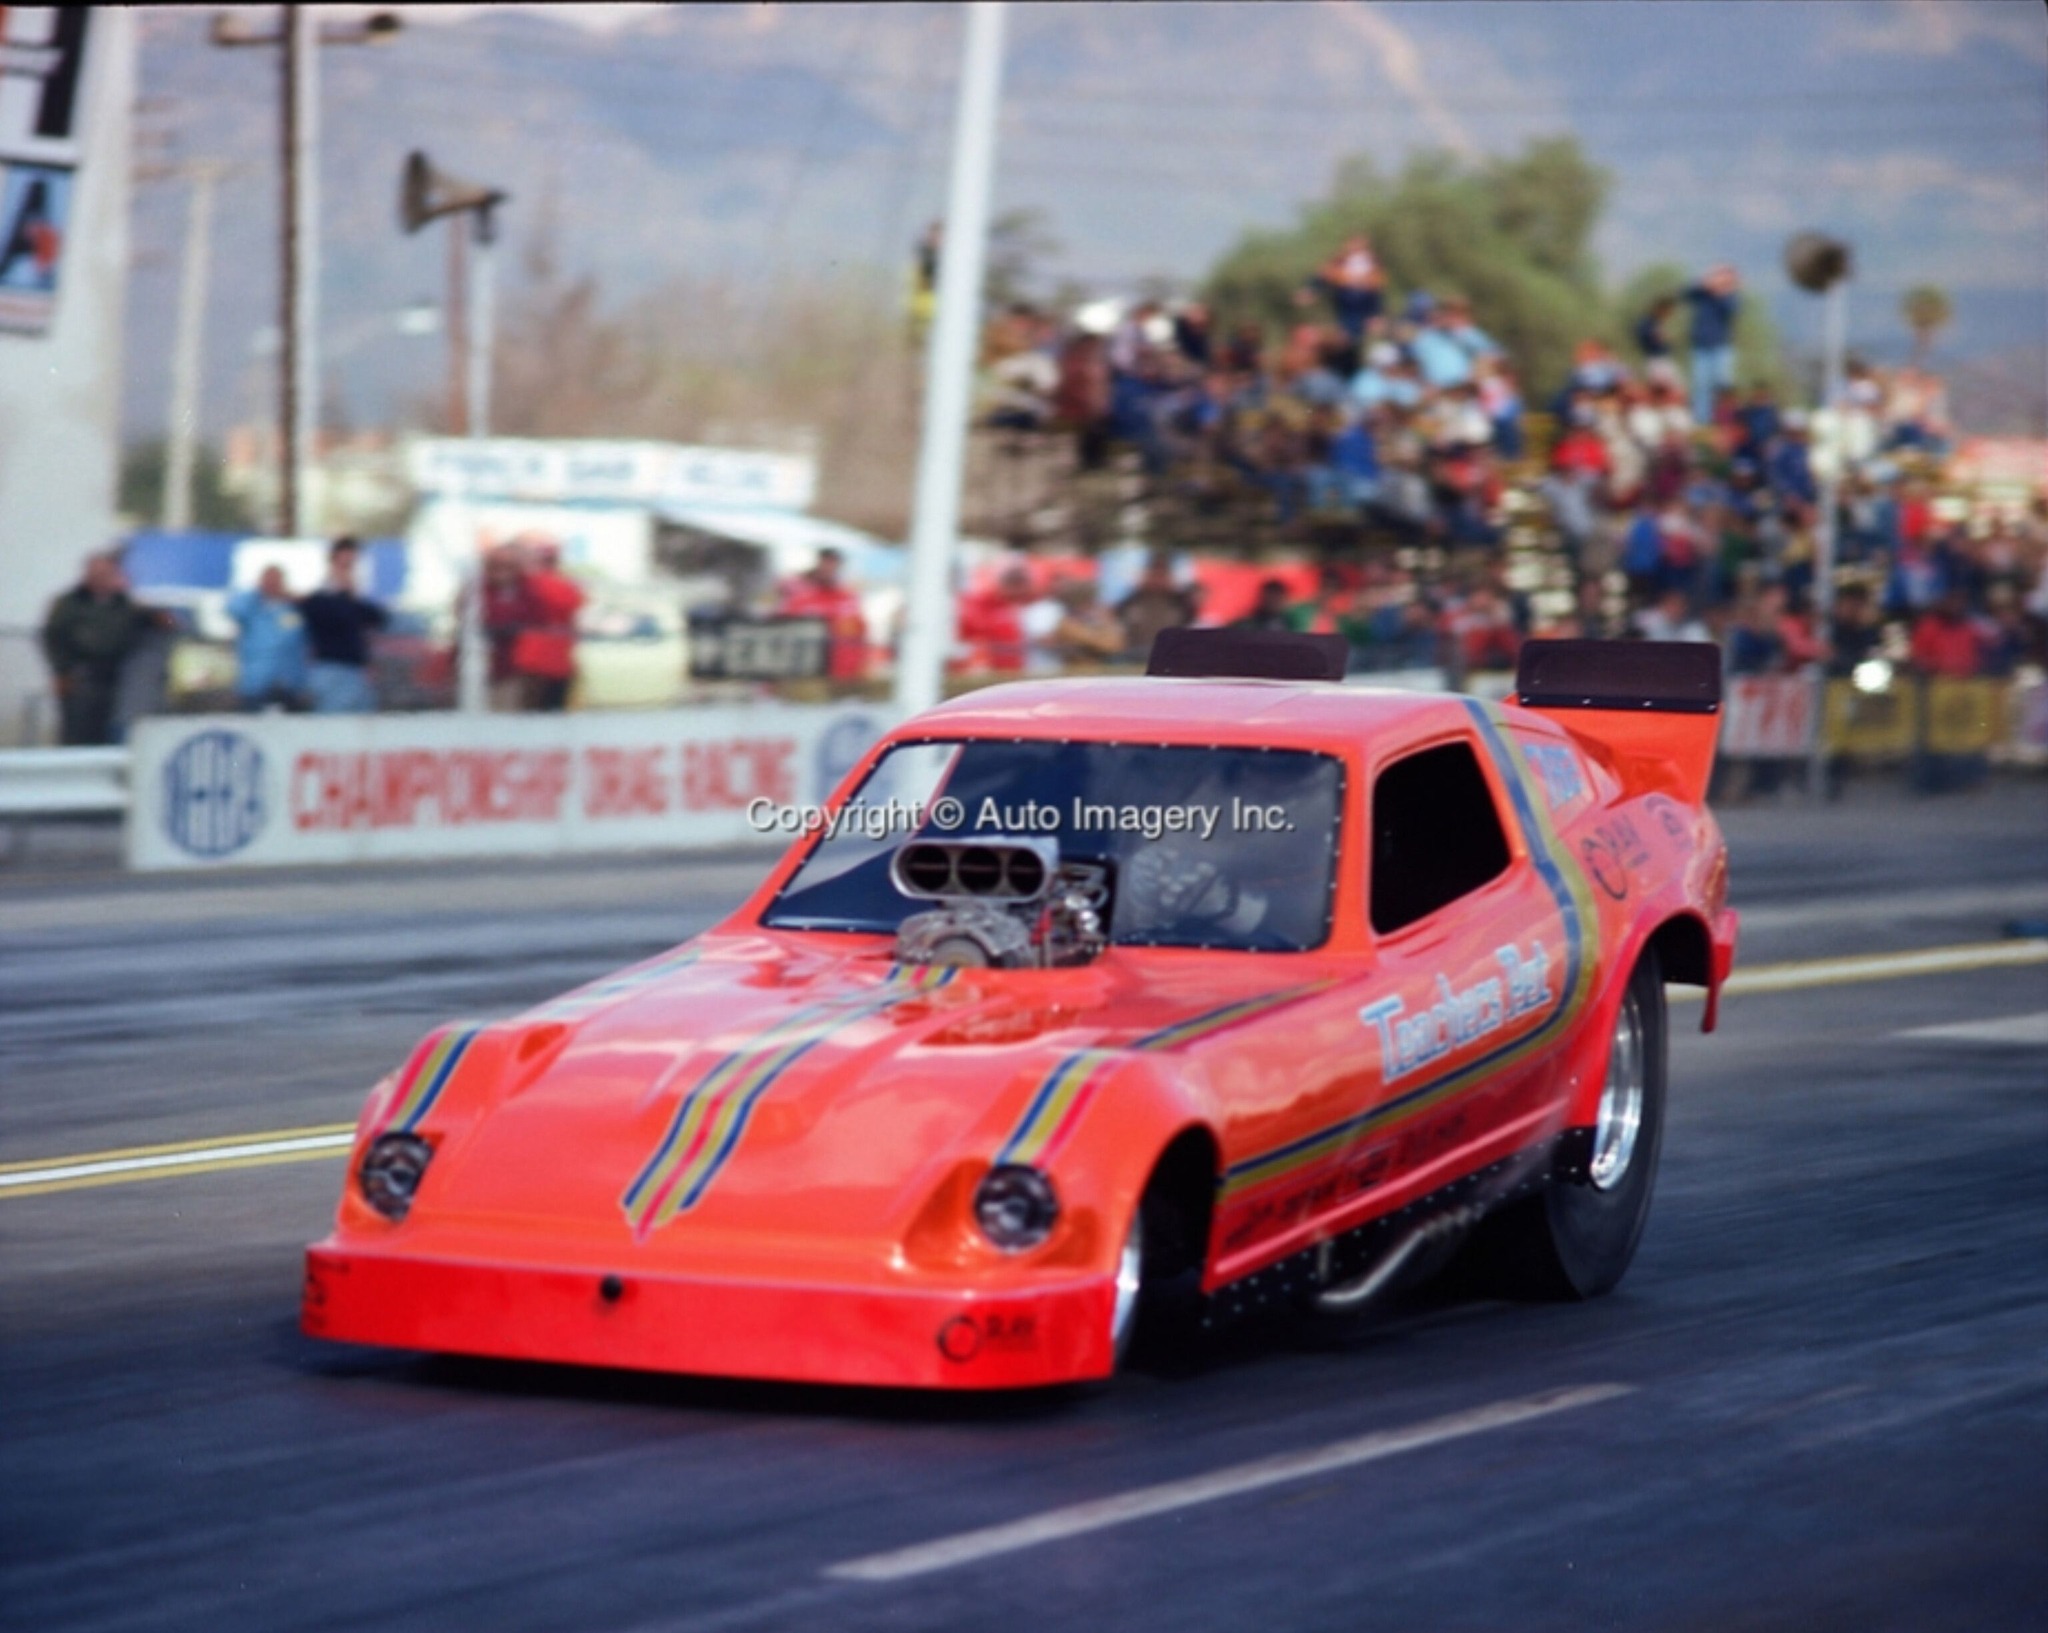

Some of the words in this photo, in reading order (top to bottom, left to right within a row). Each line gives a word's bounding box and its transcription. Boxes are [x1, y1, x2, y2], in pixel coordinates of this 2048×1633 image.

[292, 747, 570, 833] CHAMPIONSHIP
[582, 741, 668, 820] DRAG
[680, 734, 800, 815] RACING
[1358, 973, 1504, 1087] Teachers
[1495, 939, 1554, 1022] Pet
